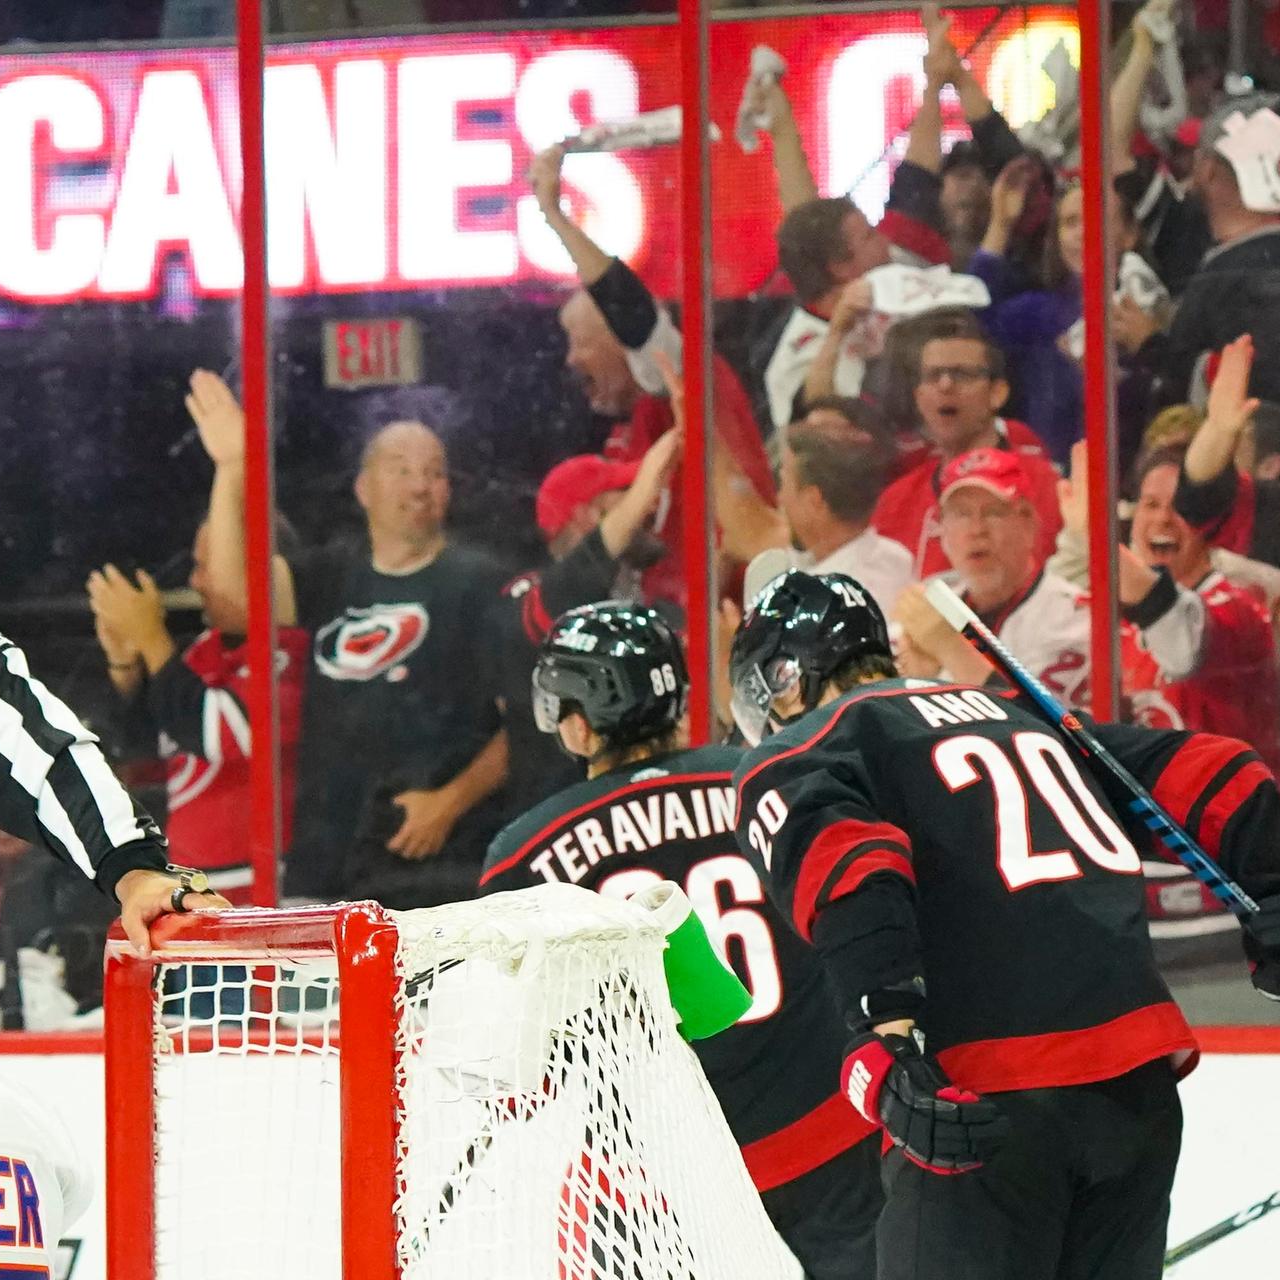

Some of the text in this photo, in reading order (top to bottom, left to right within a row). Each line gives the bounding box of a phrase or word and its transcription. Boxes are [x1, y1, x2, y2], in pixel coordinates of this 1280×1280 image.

[335, 319, 402, 381] EXIT
[639, 662, 677, 698] 86
[908, 688, 1010, 729] AHO
[747, 788, 789, 874] 20
[930, 729, 1144, 893] 20
